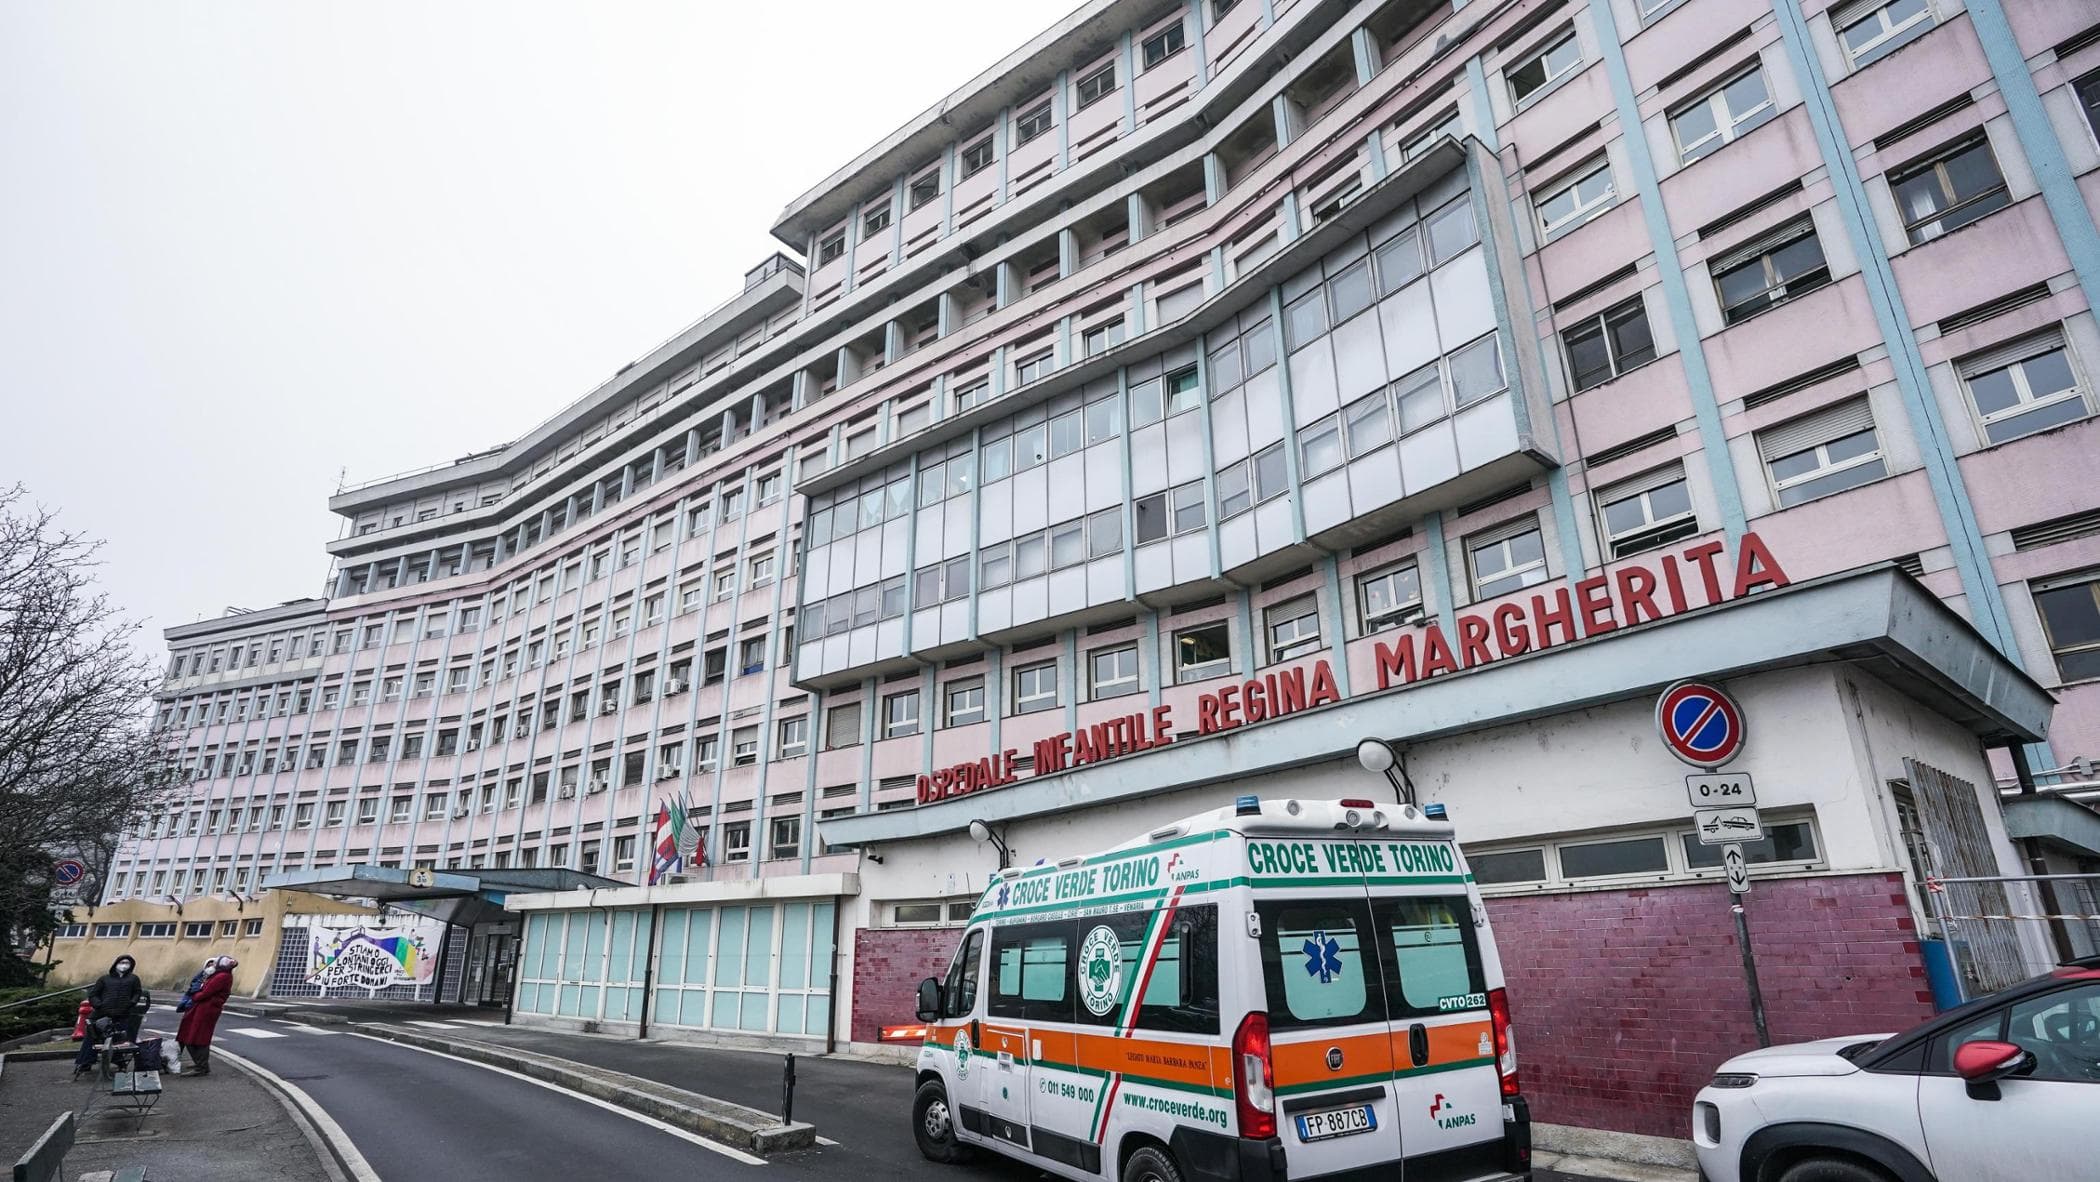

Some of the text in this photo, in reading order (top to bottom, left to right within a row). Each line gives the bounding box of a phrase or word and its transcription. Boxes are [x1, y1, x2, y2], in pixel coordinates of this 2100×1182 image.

[917, 532, 1791, 804] OSPEDALE INFANTILE REGINA MARGHERITA
[1248, 842, 1454, 874] CROCE VERDE TORINO
[1012, 856, 1160, 906] CROCE VERDE TORINO
[1175, 869, 1200, 881] ANPAS
[337, 954, 389, 967] LONTANI OGGI
[349, 944, 380, 958] STIAMO
[1080, 932, 1099, 975] CROCE
[1104, 931, 1120, 973] VERDE
[328, 966, 344, 976] PER
[348, 963, 393, 976] STRINGERCI
[332, 973, 359, 986] FORTE
[361, 975, 387, 986] DOMANI
[1086, 991, 1113, 1011] TORINO
[1440, 995, 1485, 1009] CVTO 262
[1047, 1080, 1094, 1103] 011 549 000
[1124, 1092, 1227, 1128] www.croceverde.org
[1306, 1109, 1367, 1135] FP 887CB
[1445, 1113, 1476, 1129] ANPAS
